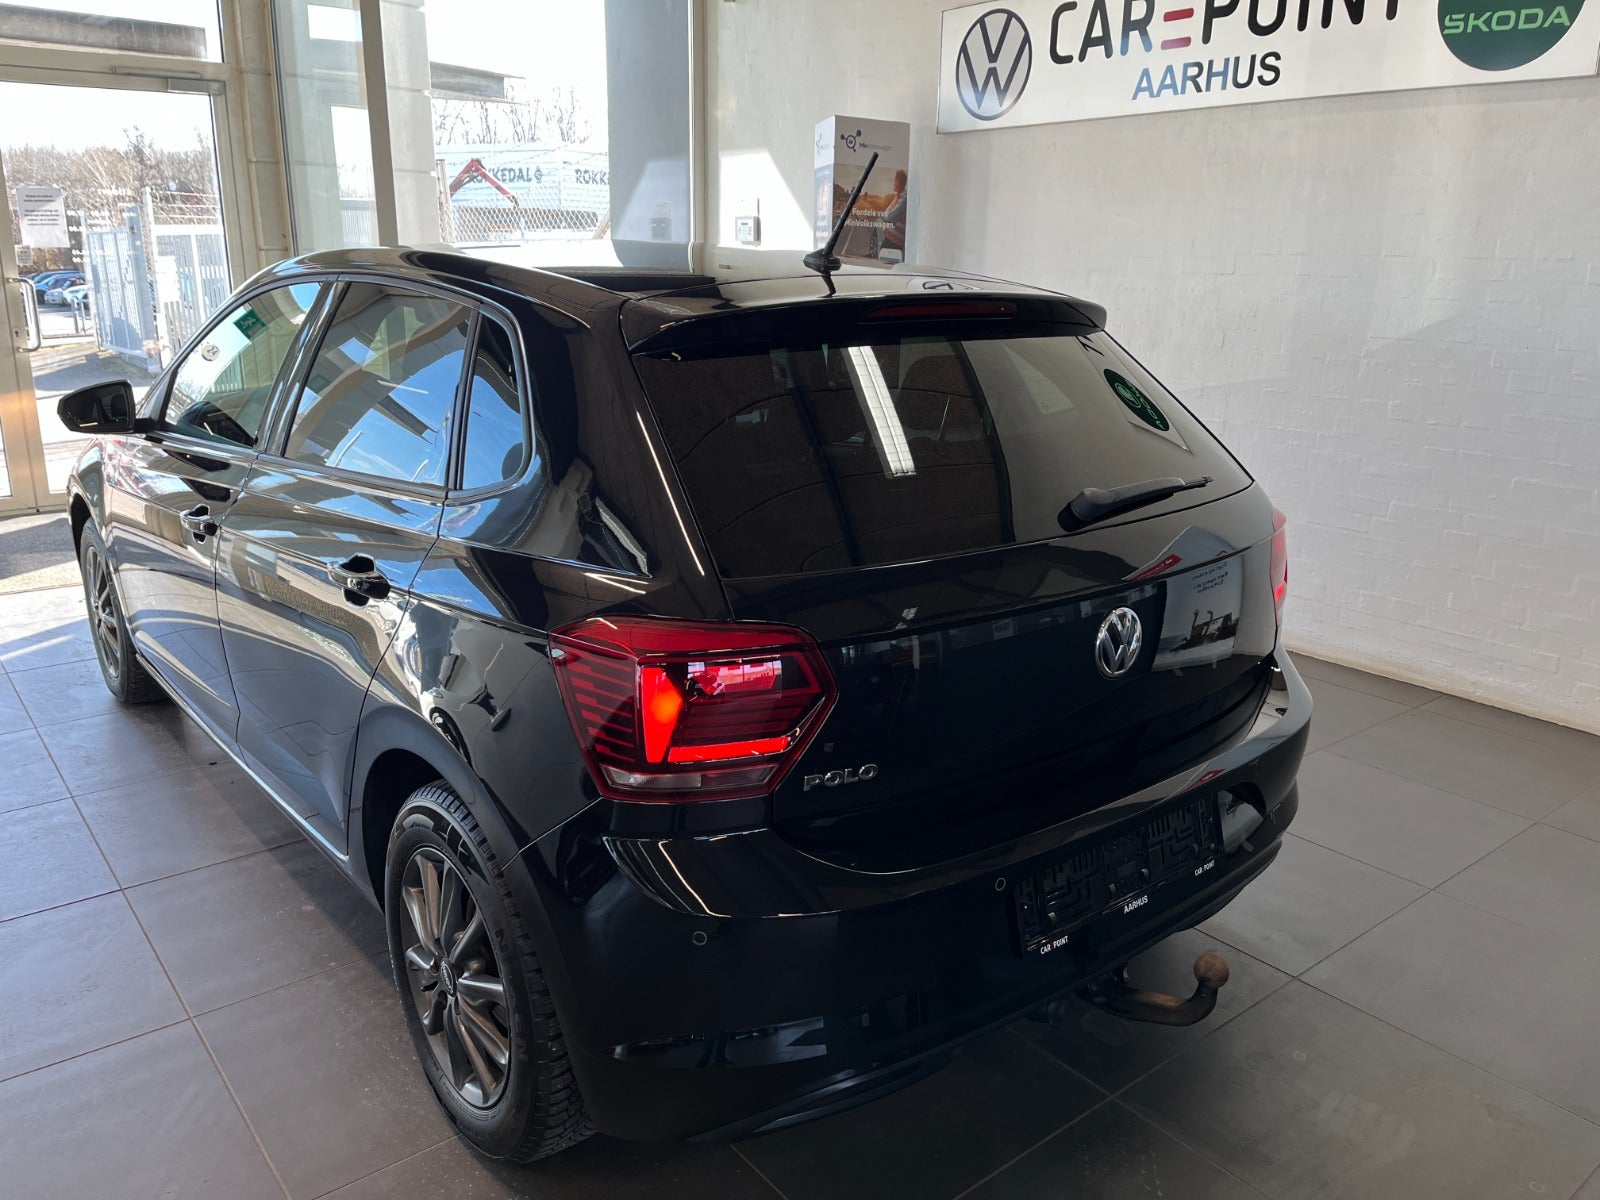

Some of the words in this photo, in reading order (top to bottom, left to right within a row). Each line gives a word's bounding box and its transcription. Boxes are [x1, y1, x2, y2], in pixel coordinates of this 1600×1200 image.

[1049, 0, 1155, 65] CAR
[1443, 5, 1571, 35] SKODA
[1131, 51, 1282, 101] AARHUS
[852, 207, 876, 217] Fordele
[803, 763, 879, 792] POLO
[1123, 894, 1149, 915] AARHUS
[1040, 943, 1052, 955] CAR
[1053, 935, 1069, 949] POINT
